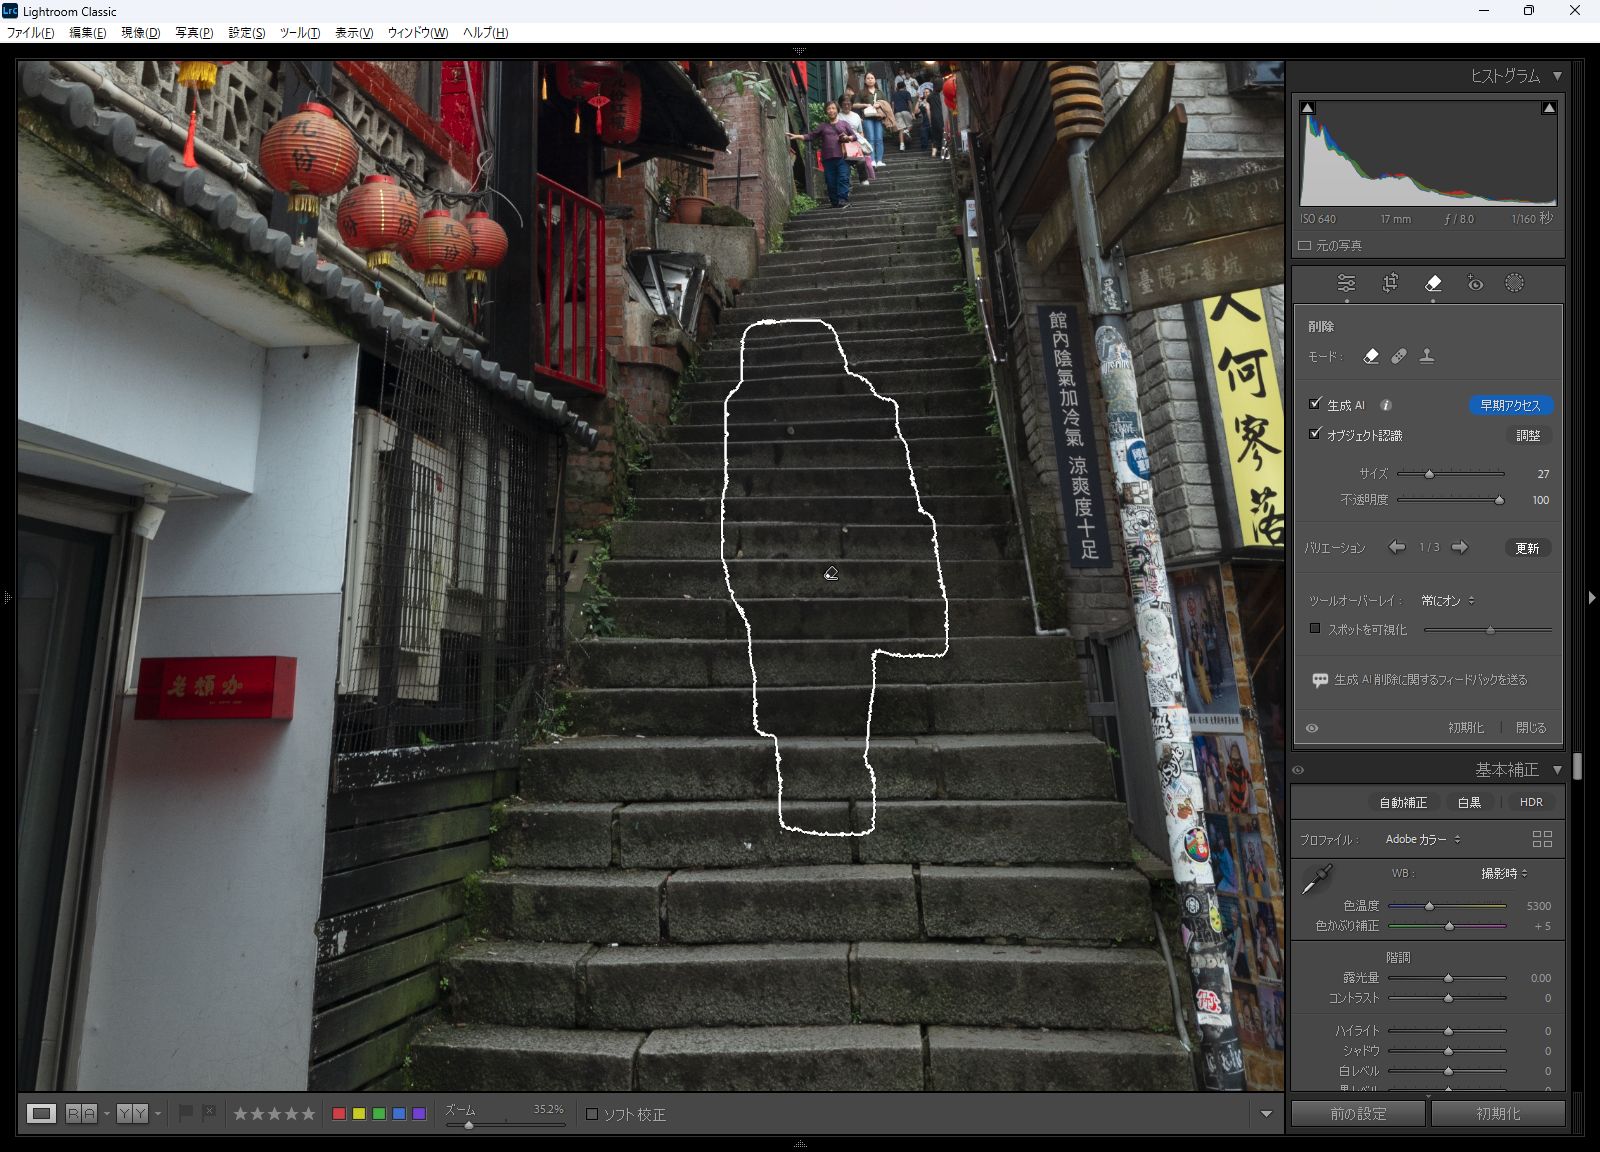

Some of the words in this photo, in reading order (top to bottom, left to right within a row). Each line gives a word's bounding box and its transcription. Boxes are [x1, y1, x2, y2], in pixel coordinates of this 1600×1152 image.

[23, 6, 78, 18] Lightroom
[81, 6, 117, 17] Classic
[7, 26, 55, 40] ファイル(F)
[69, 26, 107, 40] 編集(E)
[121, 26, 161, 40] 現像(D)
[175, 26, 214, 40] 写真(P)
[228, 26, 266, 40] 設定(S)
[280, 26, 321, 40] ツール(T)
[335, 26, 374, 40] 表示(V)
[388, 25, 449, 40] ウィンドウ(W)
[463, 25, 509, 40] ヘルプ(H)
[1472, 67, 1541, 84] ヒストグラム
[1300, 213, 1316, 225] ISO
[1317, 214, 1337, 224] 640
[1380, 214, 1391, 225] 17
[1393, 216, 1412, 224] mm
[1459, 214, 1475, 224] 8.0
[1512, 213, 1537, 225] 1/160
[1539, 210, 1554, 225] 秒
[1316, 239, 1363, 252] 元の写真
[1308, 320, 1335, 333] 削除
[1327, 399, 1352, 412] 生成
[1354, 400, 1365, 410] AI
[1480, 399, 1541, 412] 早期アクセス
[1048, 311, 1084, 448] 館內陰氣加冷氣
[1068, 455, 1100, 561] 涼爽度十足
[1327, 429, 1403, 442] オブジェクト認識
[1516, 429, 1541, 442] 調整
[1359, 467, 1389, 480] サイズ
[1537, 469, 1550, 479] 27
[1340, 493, 1389, 506] 不透明度
[1532, 495, 1550, 505] 100
[1304, 541, 1366, 554] バリエーション
[1419, 542, 1424, 553] 1
[1433, 542, 1441, 552] 3
[1515, 542, 1540, 555] 更新
[1421, 594, 1461, 607] 常にオン
[1328, 623, 1408, 636] スポットを可視化
[1334, 673, 1359, 686] 生成
[1361, 673, 1373, 684] AI
[1374, 673, 1528, 686] 削除に関するフィードバックを送る
[1448, 721, 1485, 734] 初期化
[1516, 721, 1547, 734] 閉じる
[1475, 761, 1540, 778] 基本補正
[1380, 796, 1428, 809] 自動補正
[1458, 796, 1482, 809] 白黒
[1520, 797, 1544, 807] HDR
[1385, 833, 1418, 844] Adobe
[1419, 833, 1447, 846] カラー
[1481, 867, 1518, 880] 撮影時
[1343, 899, 1380, 912] 色温度
[1527, 901, 1552, 911] 5300
[1315, 919, 1380, 932] 色かぶり補正
[1545, 921, 1551, 931] 5
[1386, 951, 1411, 964] 階調
[1343, 971, 1380, 984] 露光量
[1530, 973, 1552, 983] 0.00
[1329, 991, 1380, 1004] コントラスト
[1544, 993, 1552, 1003] 0
[1335, 1024, 1380, 1037] ハイライト
[1544, 1026, 1552, 1036] 0
[1343, 1044, 1380, 1057] シャドウ
[1544, 1046, 1552, 1056] 0
[1339, 1064, 1380, 1077] 白レベル
[1544, 1066, 1552, 1076] 0
[445, 1103, 476, 1116] ズーム
[533, 1104, 565, 1114] 35.2%
[604, 1106, 668, 1123] ソフト校正
[1330, 1106, 1387, 1121] 前の設定
[1476, 1106, 1521, 1121] 初期化
